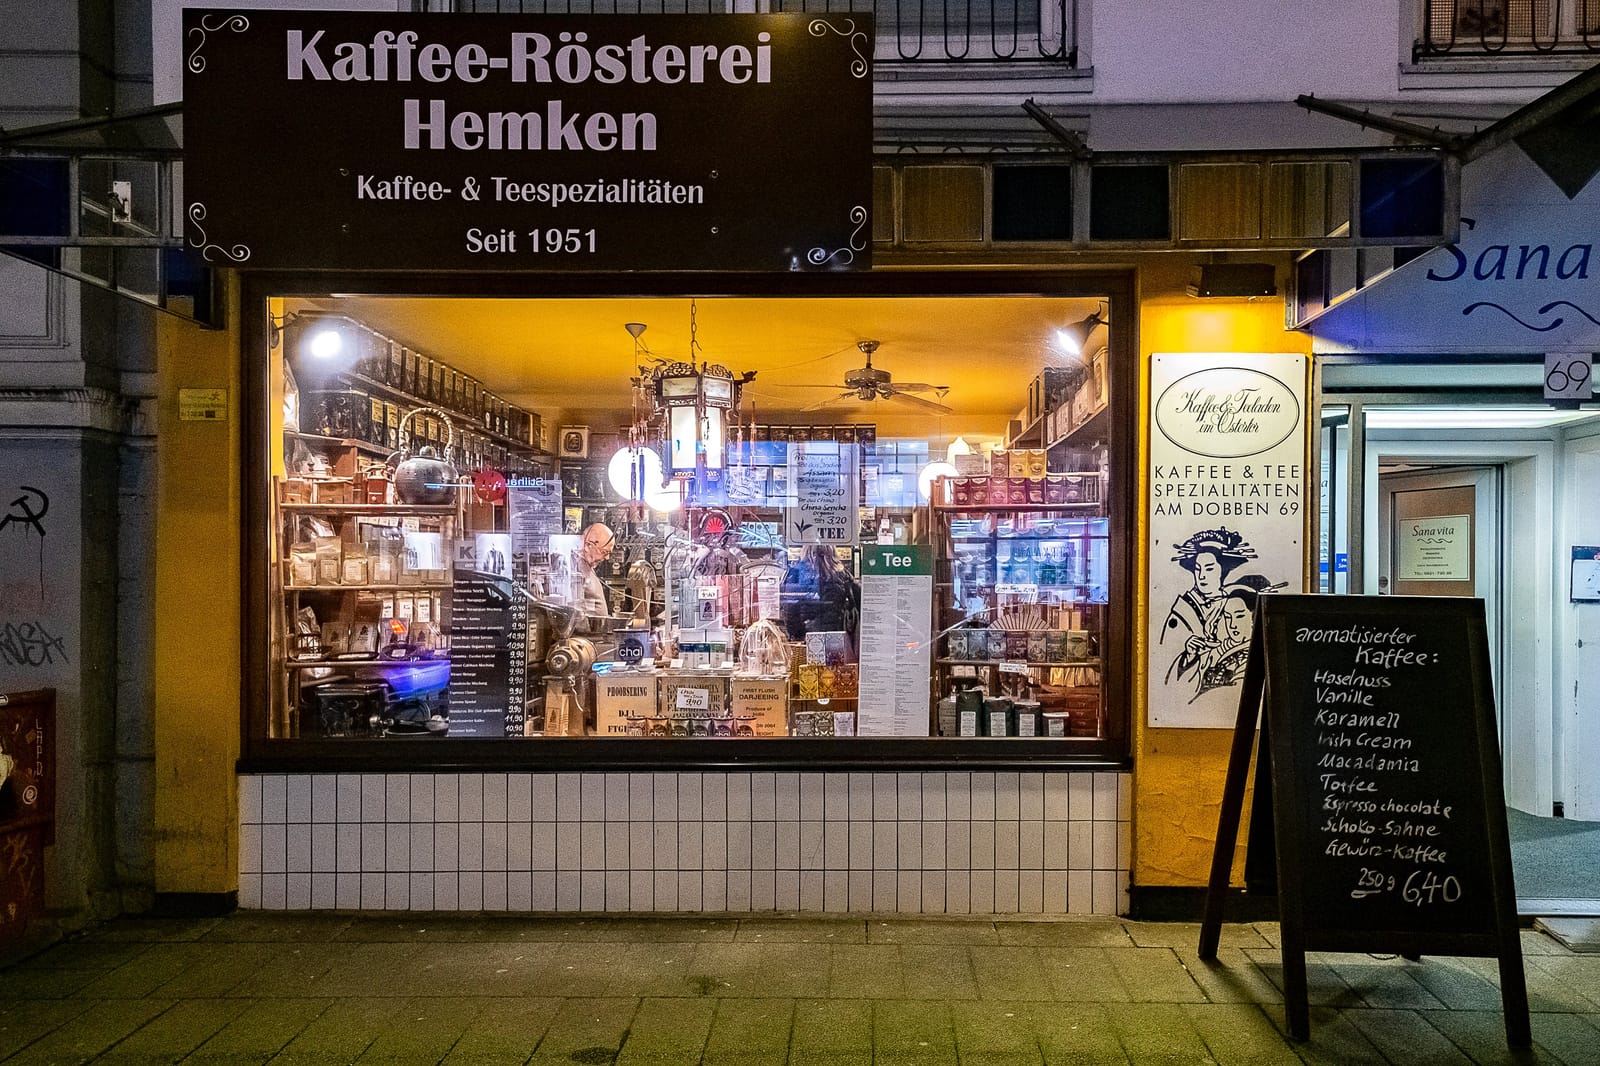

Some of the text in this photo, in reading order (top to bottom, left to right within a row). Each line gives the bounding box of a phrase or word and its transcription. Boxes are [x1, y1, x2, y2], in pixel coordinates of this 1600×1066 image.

[285, 30, 772, 84] Kaffee-Rösterei
[403, 99, 657, 152] Hemken
[357, 175, 704, 207] Kaffee- & Teespezialitäten
[466, 228, 598, 254] Seit 1951
[1426, 216, 1595, 283] Sana
[1546, 359, 1591, 392] 69
[1175, 387, 1220, 423] Kaffee
[1197, 407, 1260, 434] im Ostertor
[1154, 465, 1300, 479] KAFFEE & TEE
[1154, 483, 1300, 497] SPEZIALITÄTEN
[1154, 502, 1299, 516] AM DOBBEN 69
[817, 527, 845, 539] TEE
[882, 552, 912, 567] Tee
[1295, 624, 1417, 644] aromatisierter
[1314, 669, 1392, 688] Haselnuss
[1316, 687, 1375, 706] Vanille
[1314, 708, 1400, 729] Karamell
[1355, 732, 1412, 749] Cream
[1317, 753, 1420, 772] Macadamia
[1320, 773, 1379, 793] Toffee
[1322, 794, 1452, 819] Espresso chocolate
[1321, 817, 1441, 836] Schoko-Sahne
[1324, 837, 1447, 863] Gewürz-Kaffee
[1357, 867, 1384, 888] 250
[1402, 870, 1462, 907] 6,40
